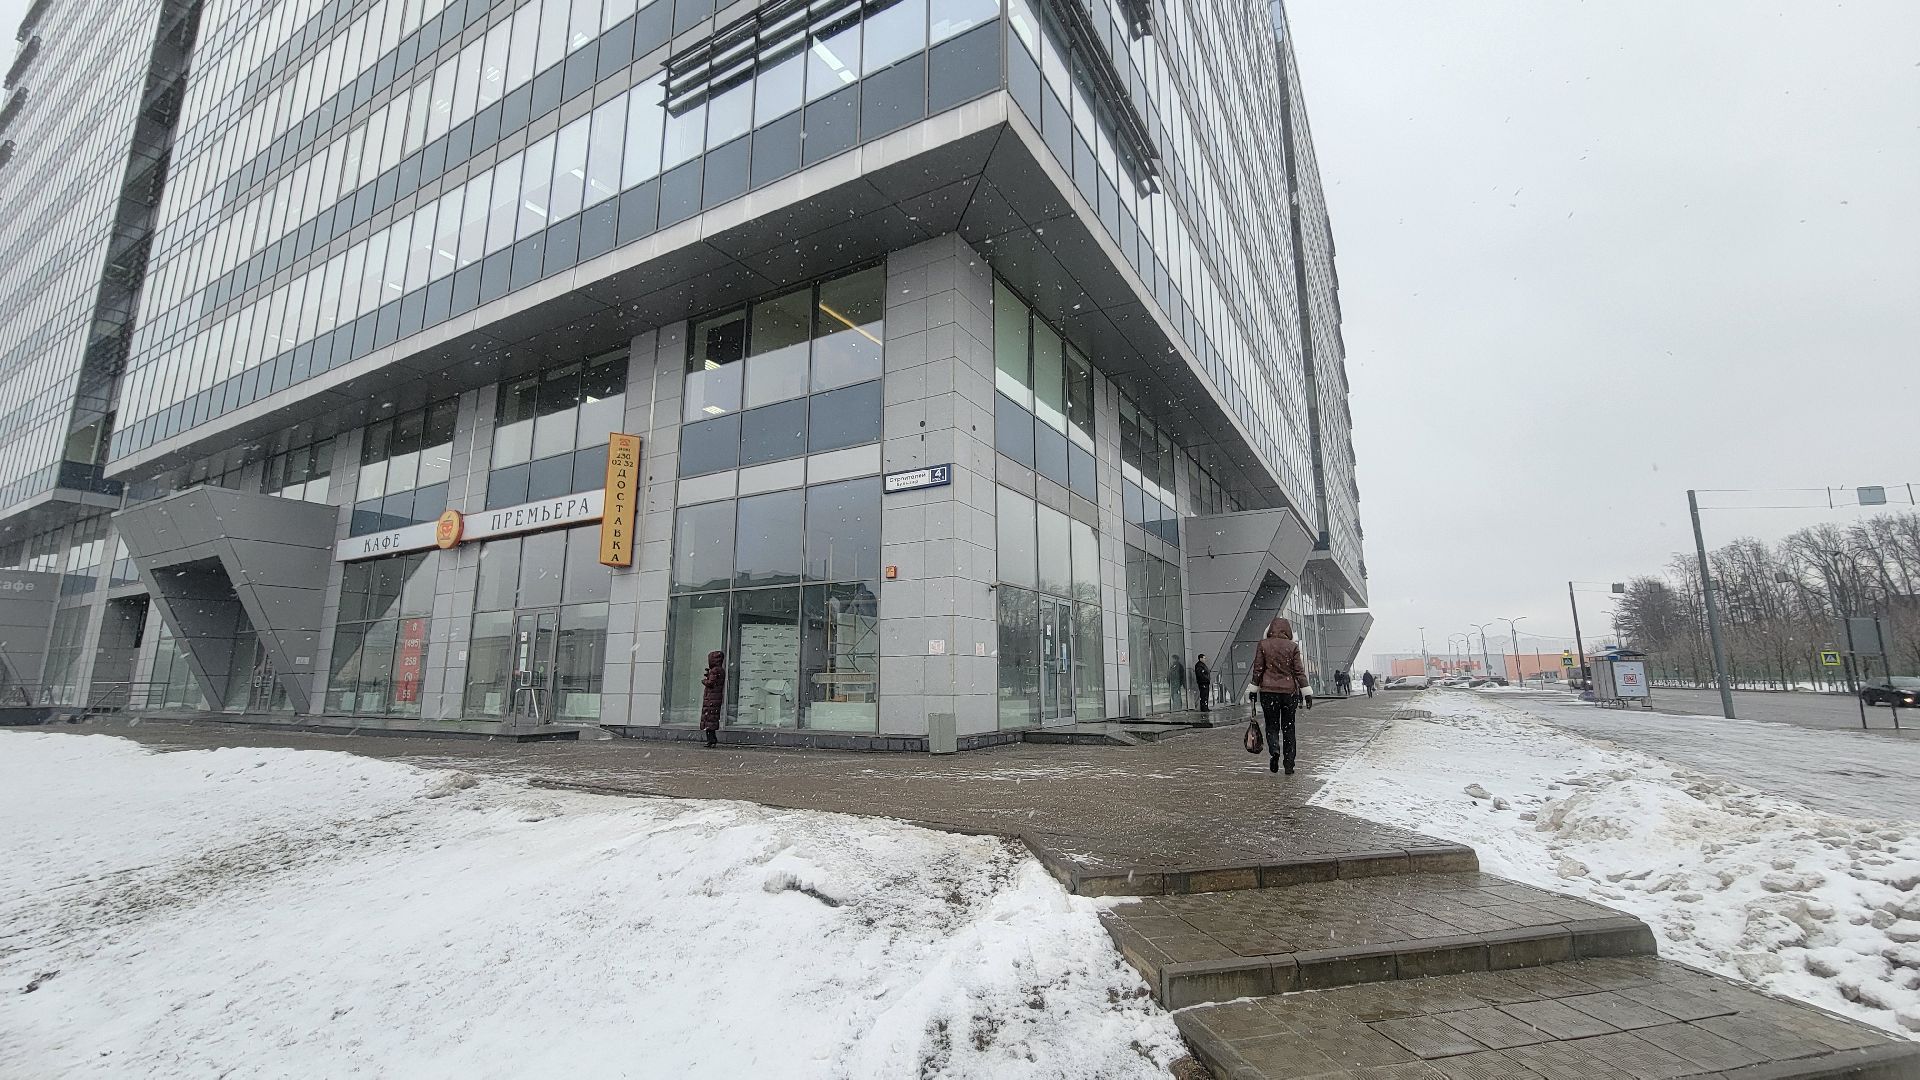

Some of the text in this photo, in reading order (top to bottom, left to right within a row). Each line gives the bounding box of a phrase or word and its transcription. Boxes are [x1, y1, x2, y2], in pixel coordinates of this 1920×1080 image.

[363, 497, 590, 553] КАФЕ ПРЕМЬЕРА
[611, 468, 626, 562] ДОСТАВКА
[0, 580, 34, 592] афе
